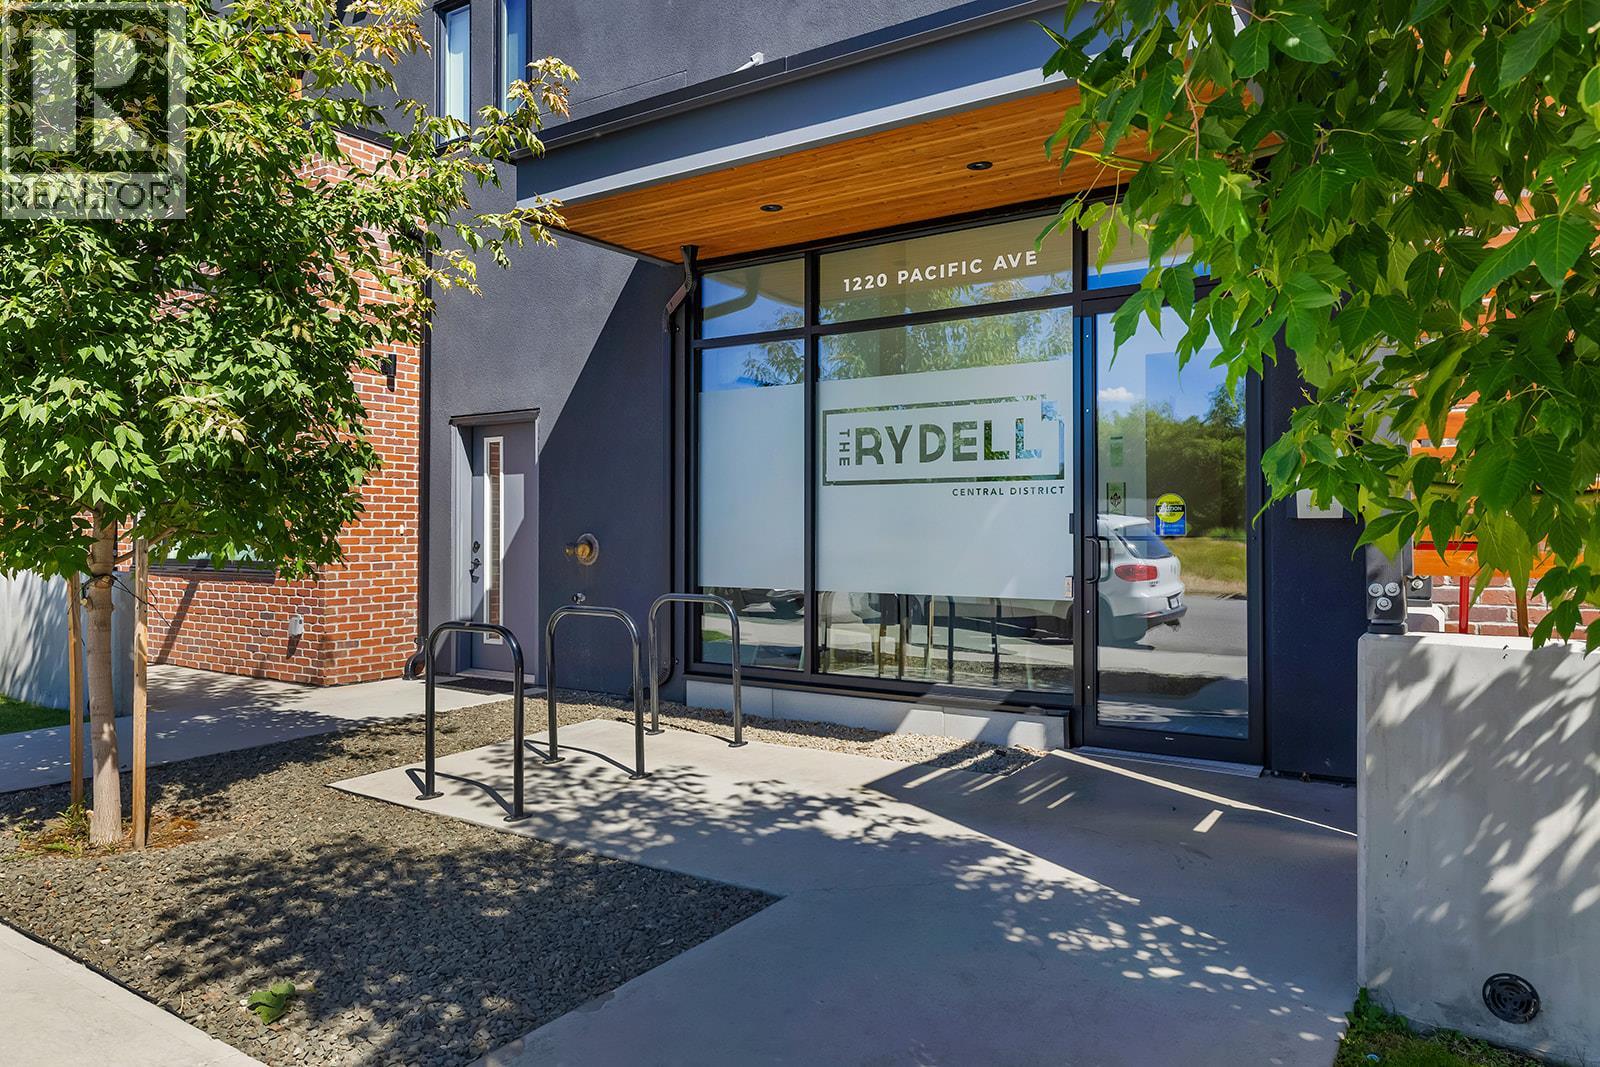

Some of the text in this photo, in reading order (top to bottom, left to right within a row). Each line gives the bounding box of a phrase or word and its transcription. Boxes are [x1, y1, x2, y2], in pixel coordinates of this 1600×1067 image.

[843, 250, 1038, 292] 1220 PACIFIC AVE
[838, 428, 850, 466] THE
[855, 418, 1042, 465] RYDELL
[952, 485, 1065, 497] CENTRAL DISTRICT
